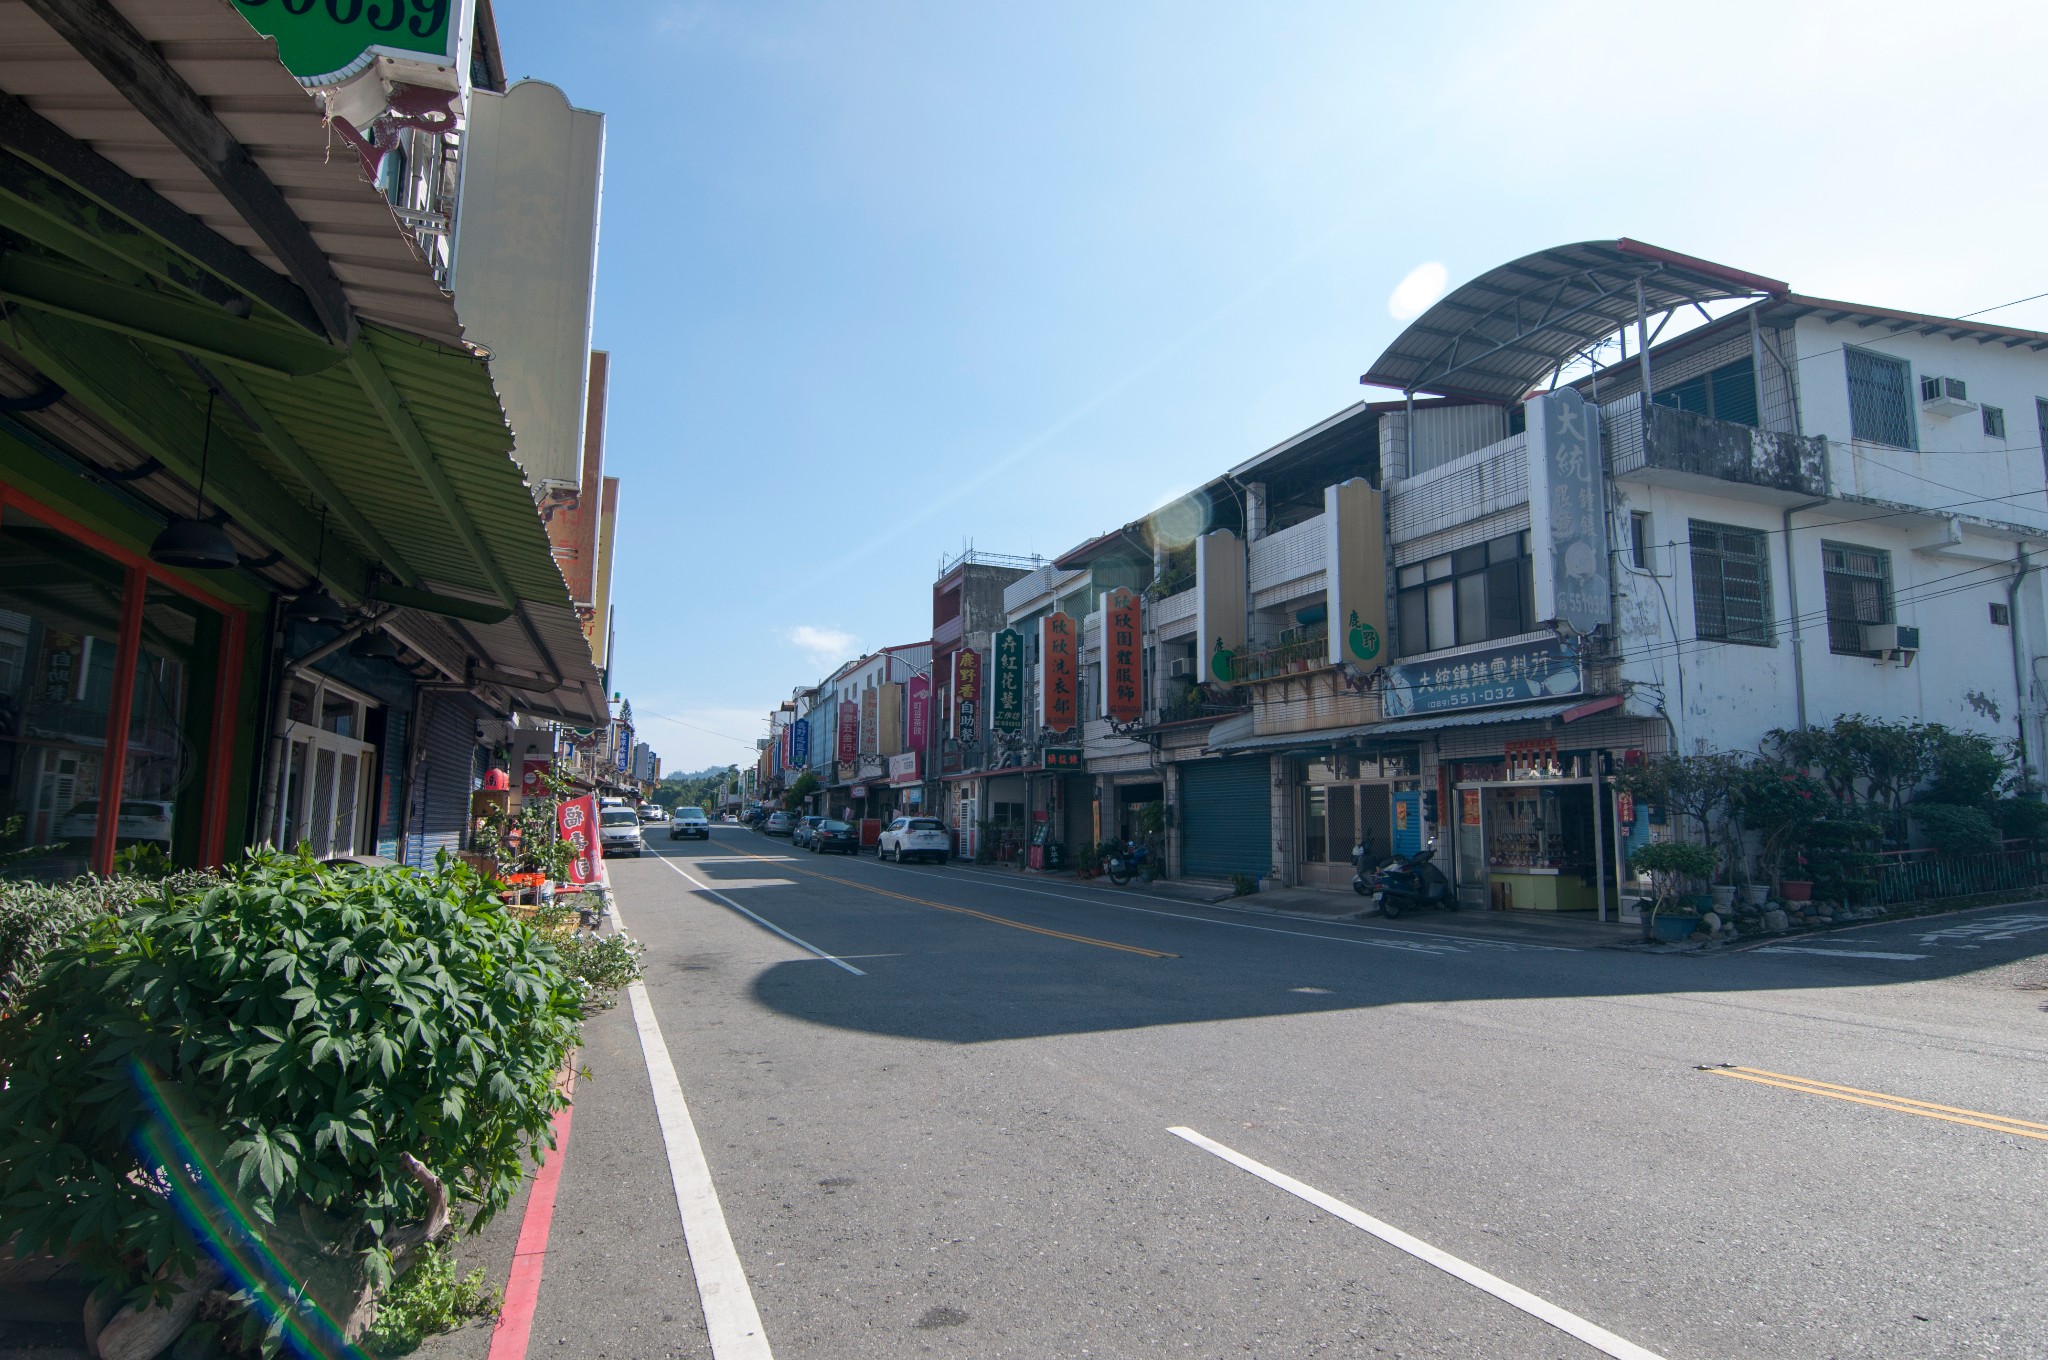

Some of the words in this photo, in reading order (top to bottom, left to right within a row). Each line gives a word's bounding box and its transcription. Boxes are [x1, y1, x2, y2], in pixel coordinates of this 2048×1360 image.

[1556, 402, 1592, 483] 大統
[1114, 595, 1134, 703] 欣欣團體服飾
[1349, 610, 1376, 650] 鹿野
[959, 652, 978, 698] 鹿野香
[1052, 619, 1070, 715] 欣欣洗衣部
[1418, 650, 1551, 695] 大統鐘錶電料行
[1428, 687, 1515, 709] (089)551-032
[960, 701, 974, 741] 自助餐
